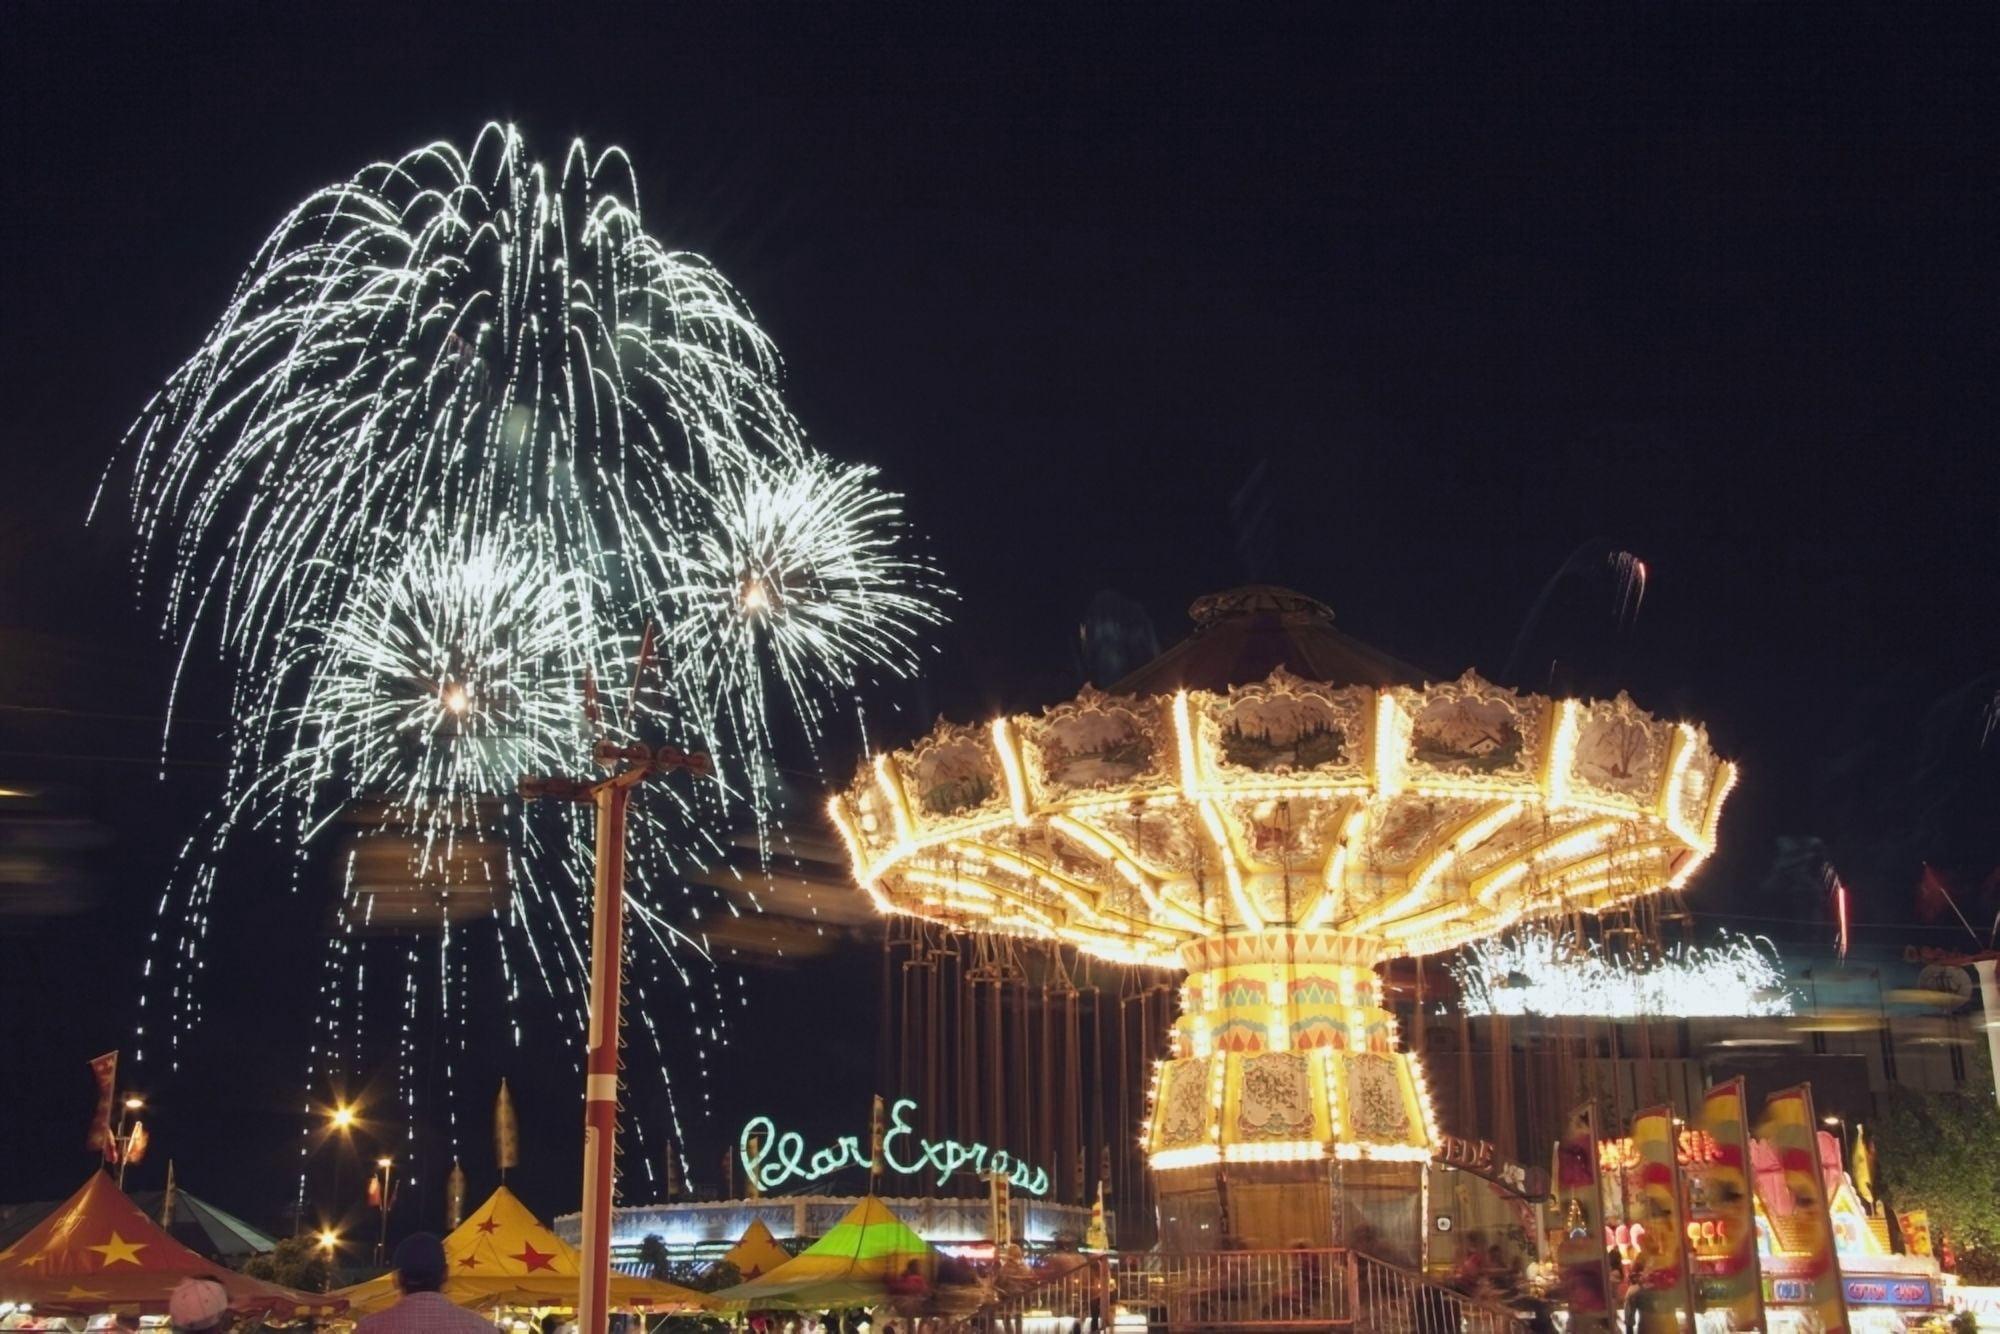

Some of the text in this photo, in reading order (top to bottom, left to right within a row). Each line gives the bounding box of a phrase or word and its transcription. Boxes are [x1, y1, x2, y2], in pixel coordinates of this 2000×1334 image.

[741, 1099, 1048, 1195] Polar Express
[1848, 1281, 1925, 1301] COTTON CANDY
